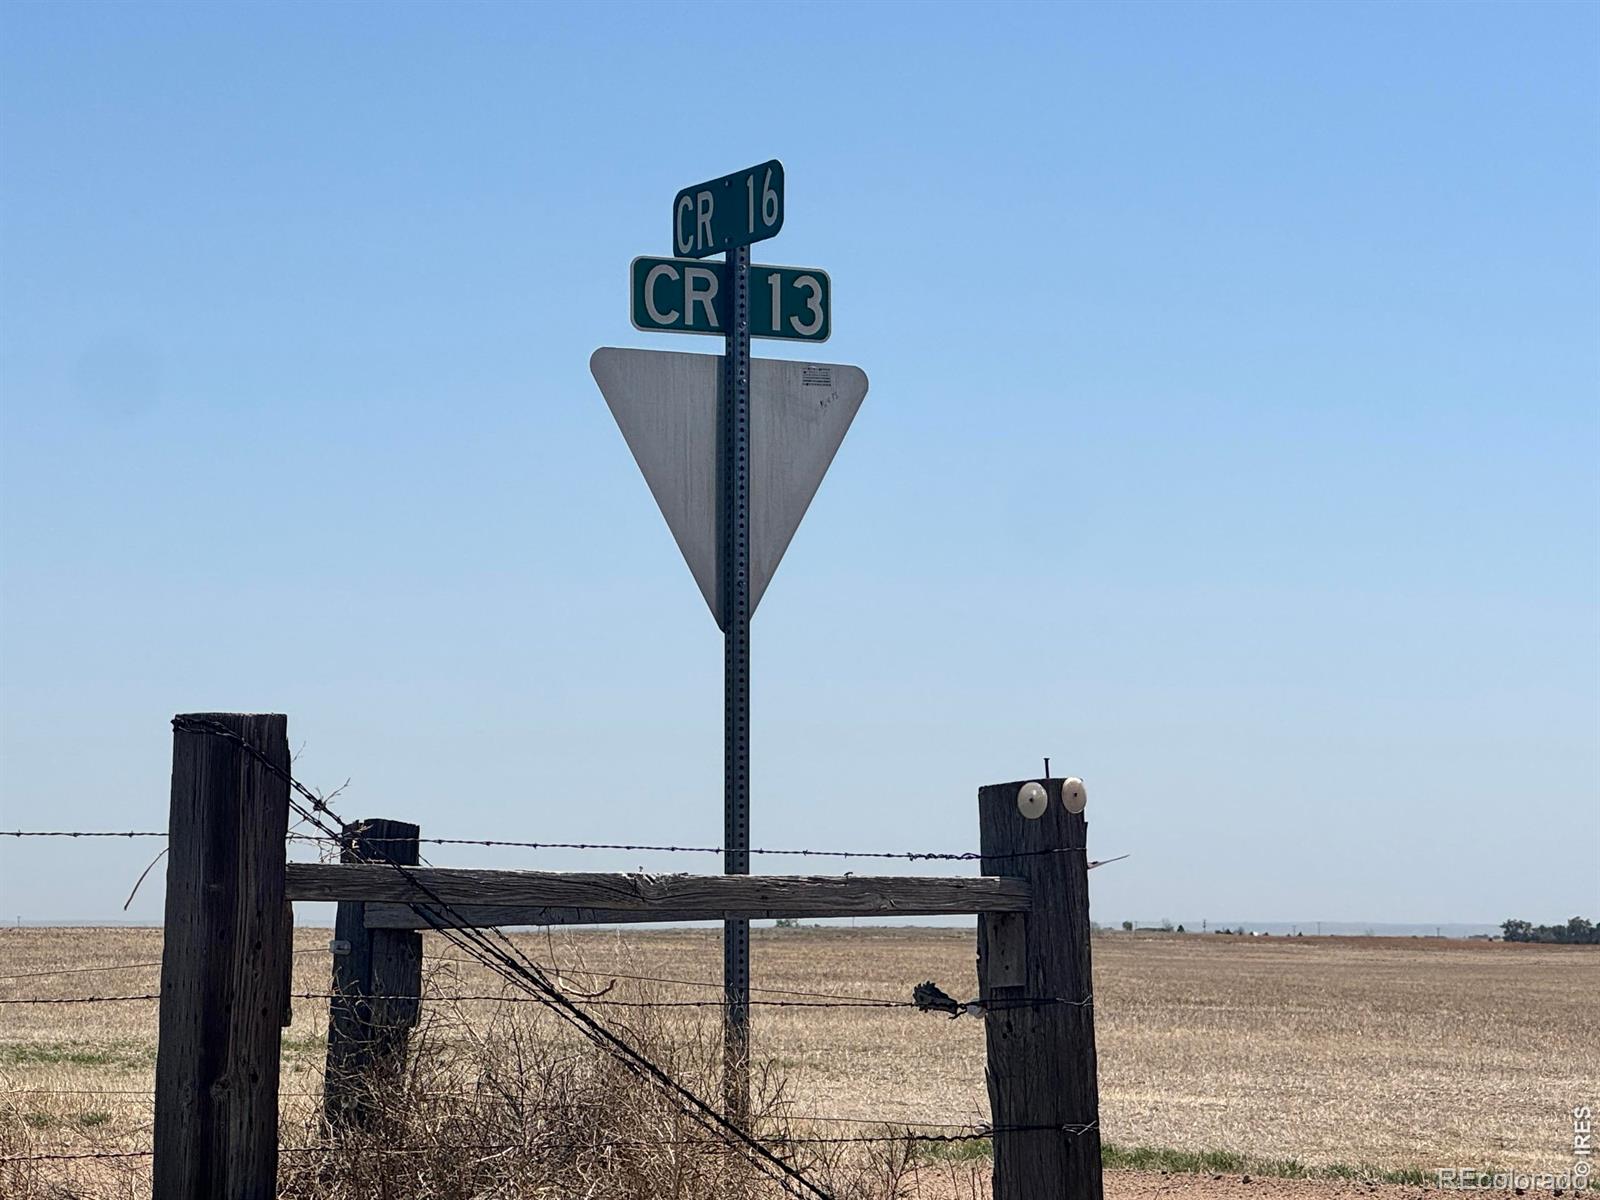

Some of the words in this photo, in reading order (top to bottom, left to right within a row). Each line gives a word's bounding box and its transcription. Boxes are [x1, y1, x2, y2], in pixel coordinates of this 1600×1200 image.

[677, 191, 714, 253] CR
[747, 168, 778, 233] 16
[645, 264, 719, 327] CR
[768, 273, 823, 335] 13
